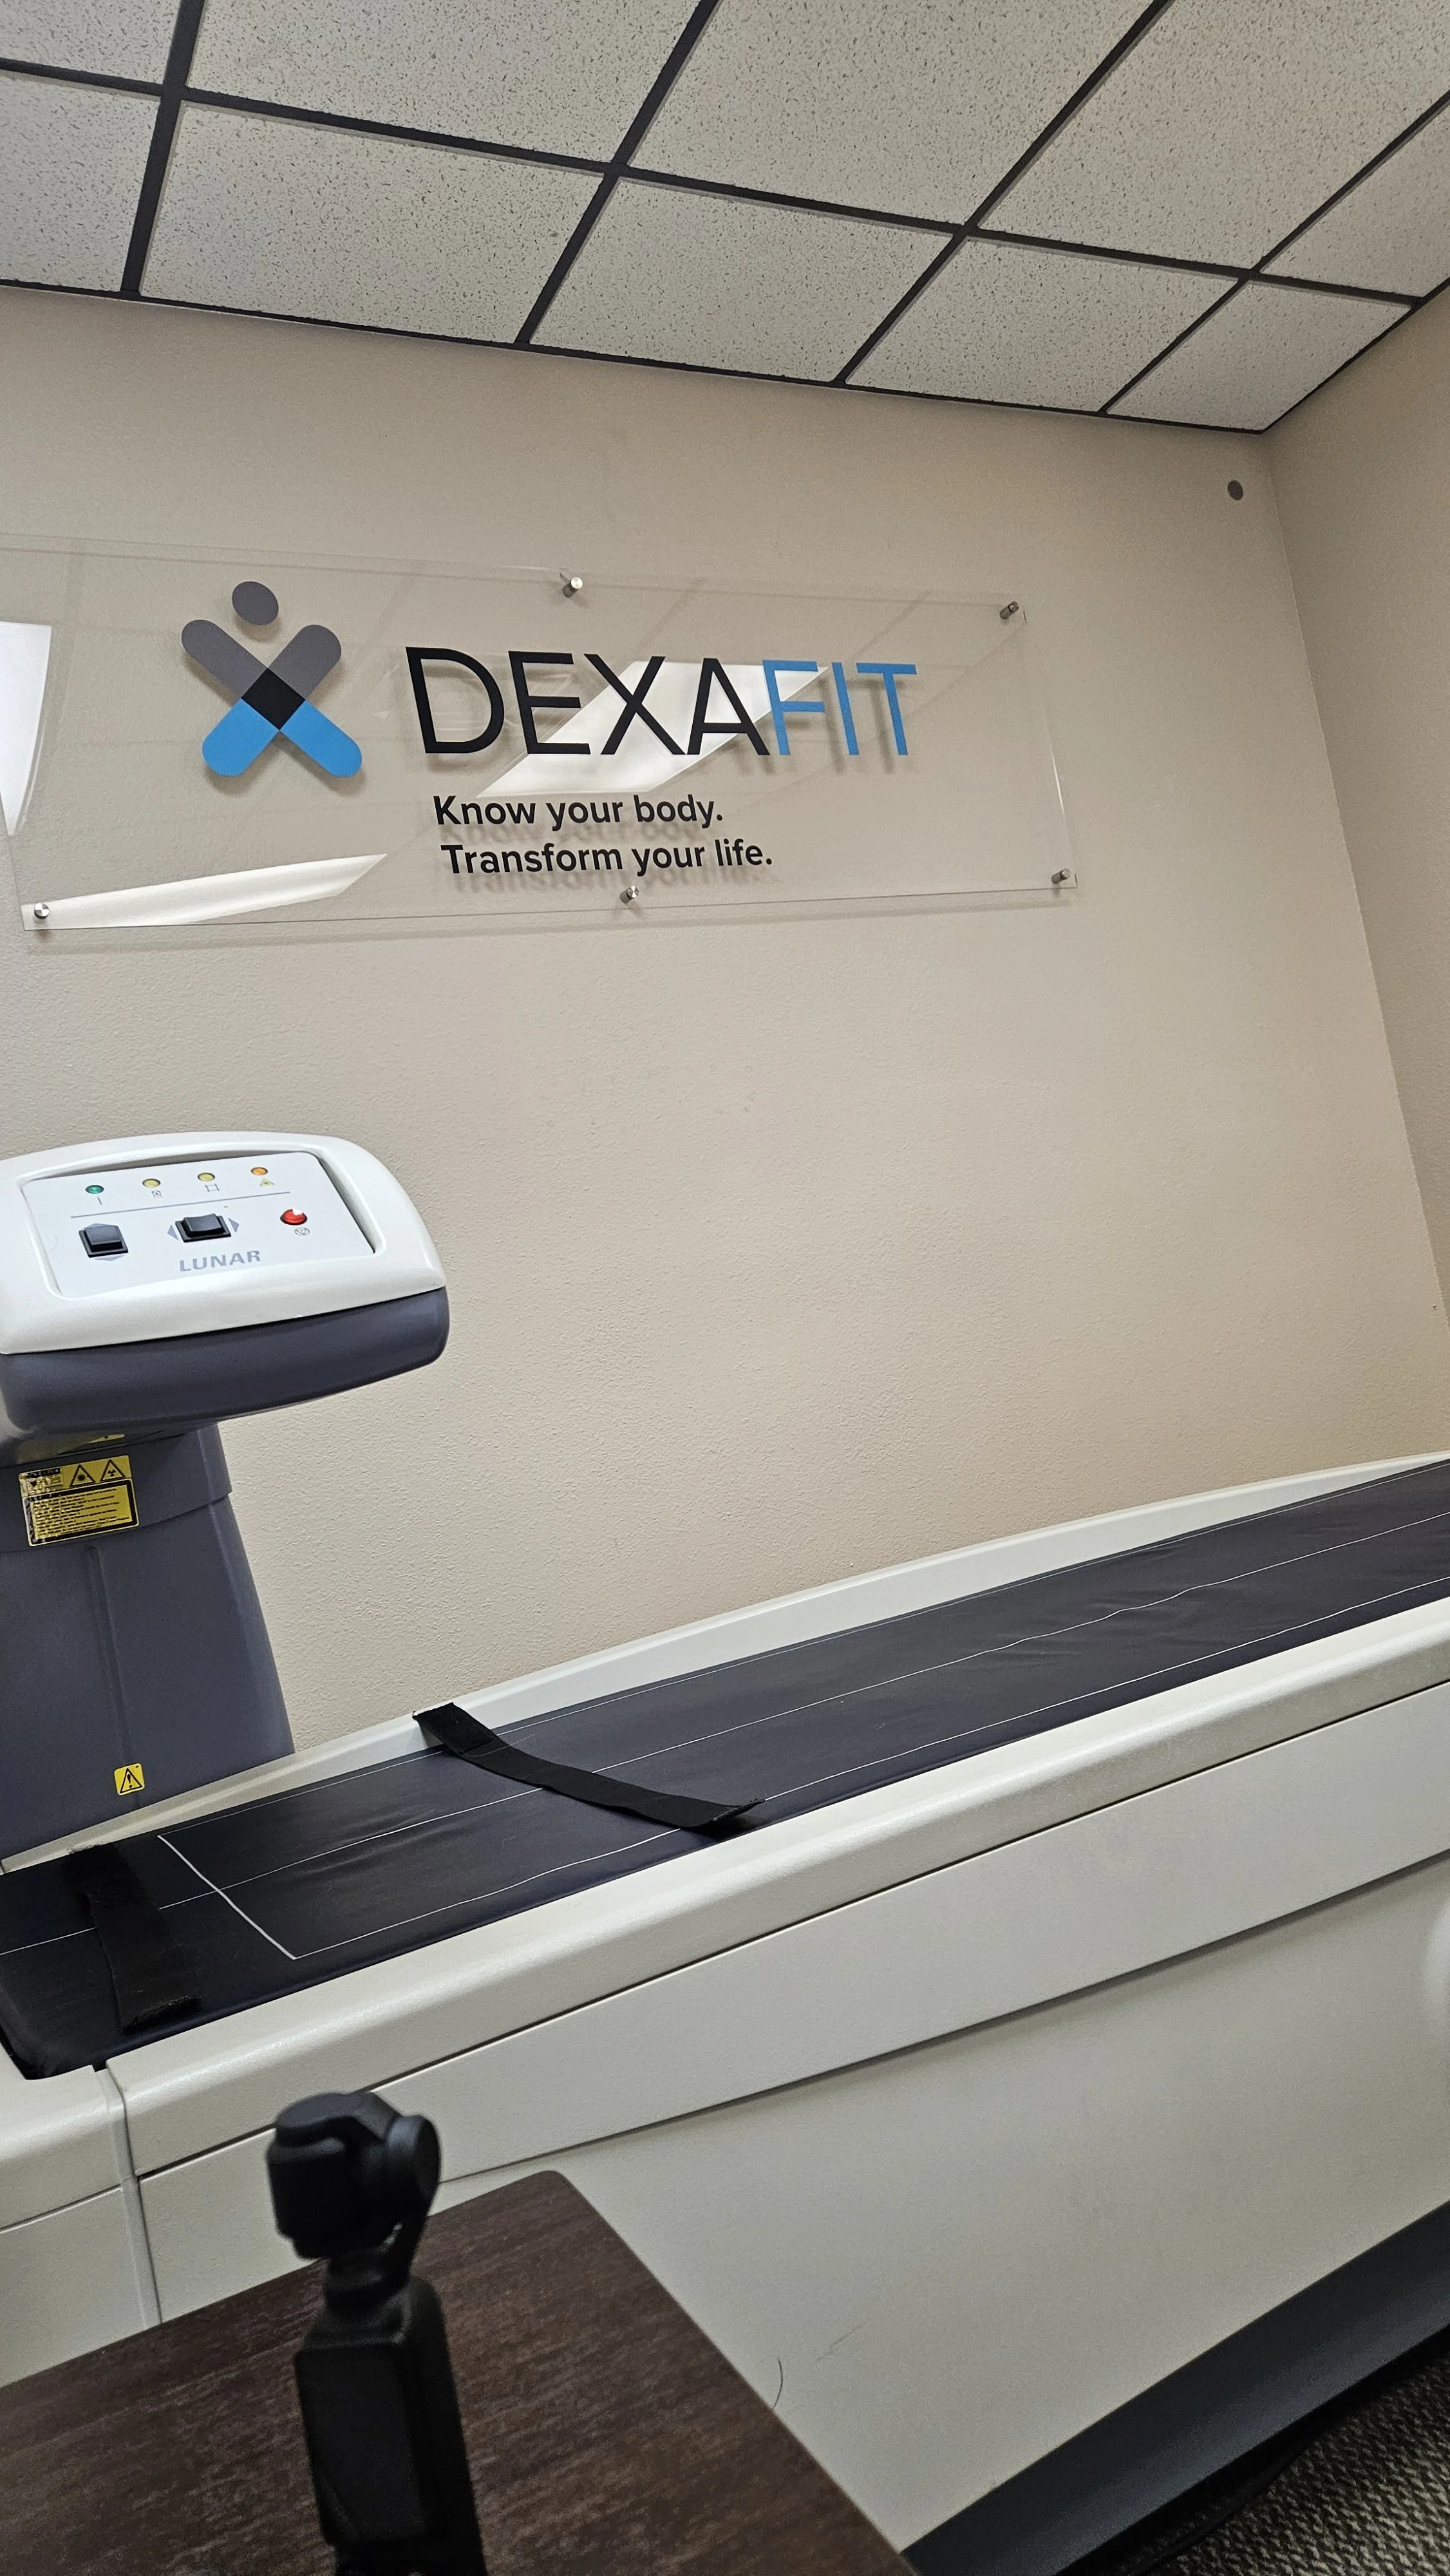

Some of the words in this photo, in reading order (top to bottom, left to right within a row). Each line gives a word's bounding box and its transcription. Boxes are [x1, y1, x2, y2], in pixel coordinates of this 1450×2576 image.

[406, 646, 917, 756] DEXAFIT
[433, 795, 536, 826] Know
[545, 801, 623, 831] your
[634, 794, 723, 829] body.
[440, 843, 623, 875] Transform
[631, 846, 705, 877] your
[714, 838, 773, 867] life.
[180, 1250, 261, 1272] LUNAR
